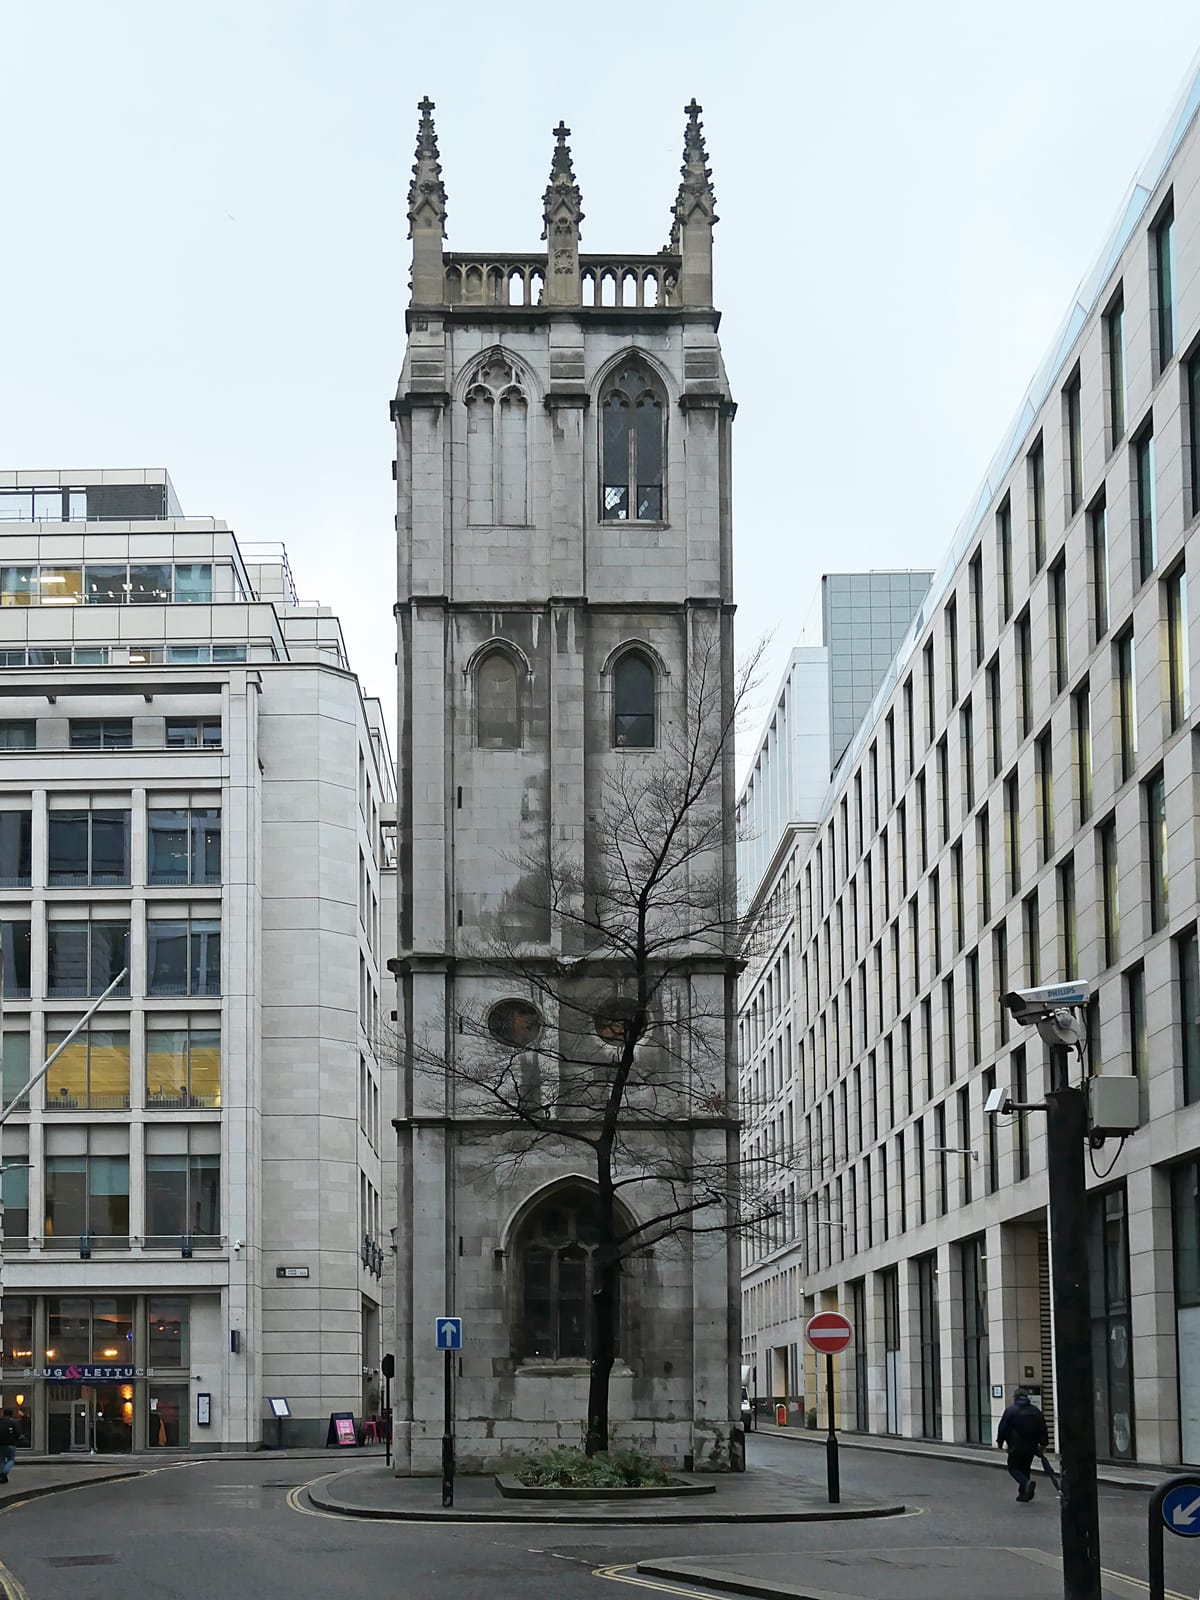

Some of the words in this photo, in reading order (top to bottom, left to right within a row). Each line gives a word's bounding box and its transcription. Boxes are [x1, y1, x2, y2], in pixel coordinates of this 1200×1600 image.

[1047, 986, 1075, 997] PHILIPS
[23, 1368, 62, 1376] SLUG
[65, 1366, 81, 1378] &
[84, 1368, 154, 1376] LETTUCE
